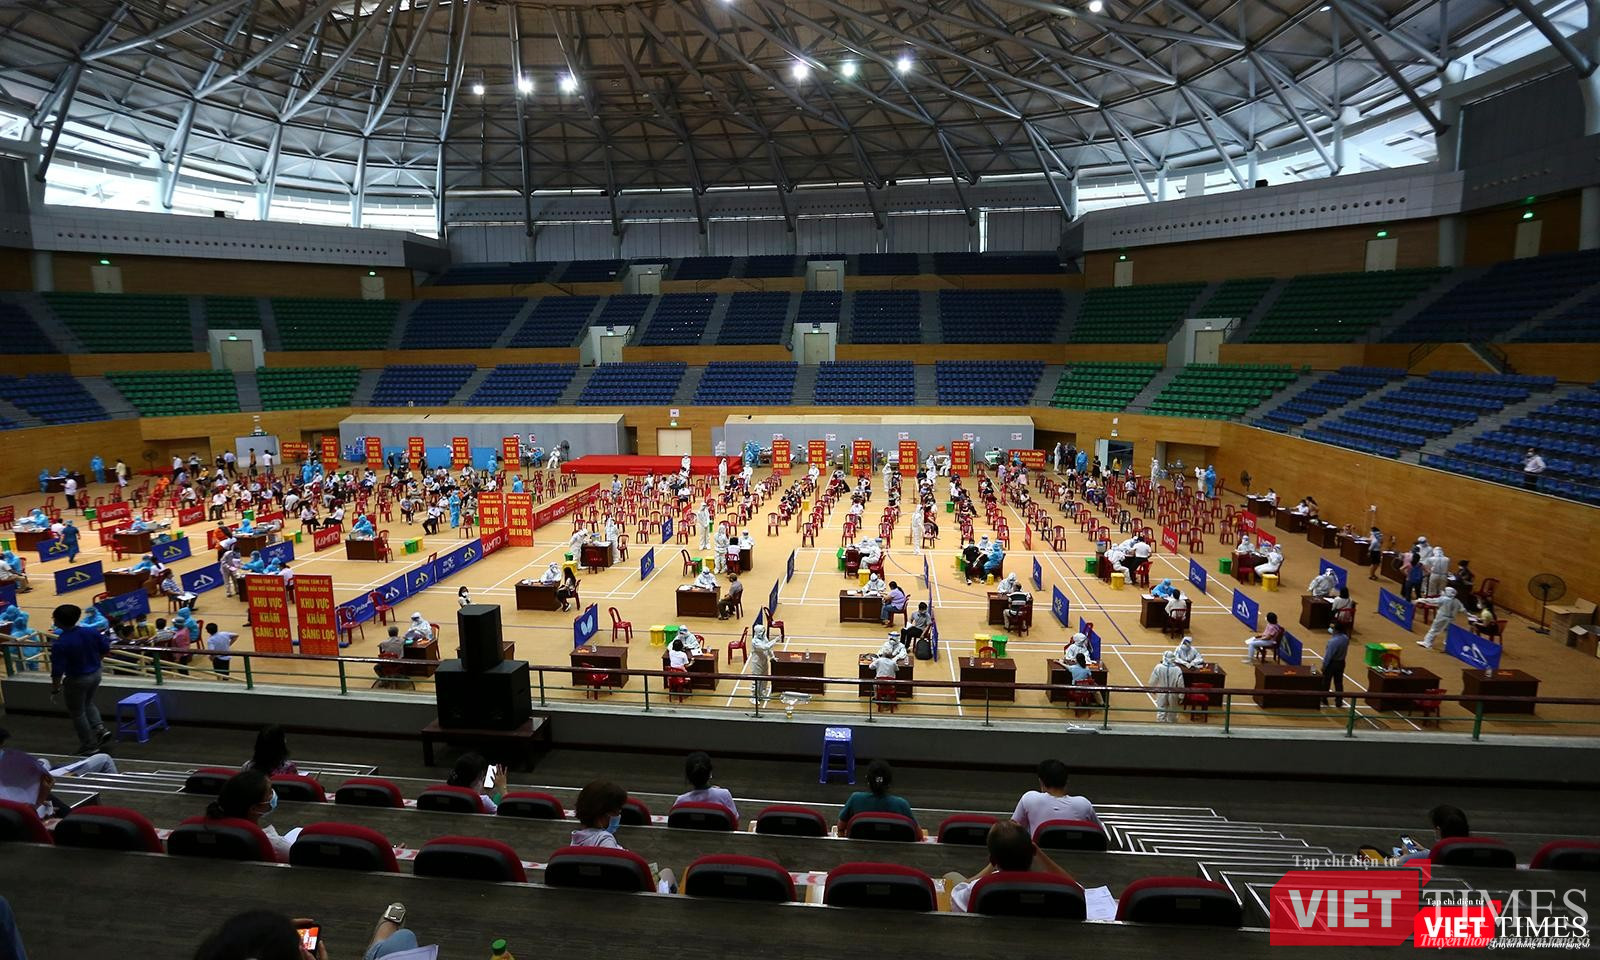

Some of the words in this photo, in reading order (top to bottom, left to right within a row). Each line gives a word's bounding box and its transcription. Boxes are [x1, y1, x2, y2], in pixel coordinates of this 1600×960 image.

[253, 597, 267, 608] KHU
[268, 597, 283, 610] VỰC
[300, 598, 314, 608] KHU
[315, 598, 330, 611] VỰC
[322, 629, 335, 642] LỌC
